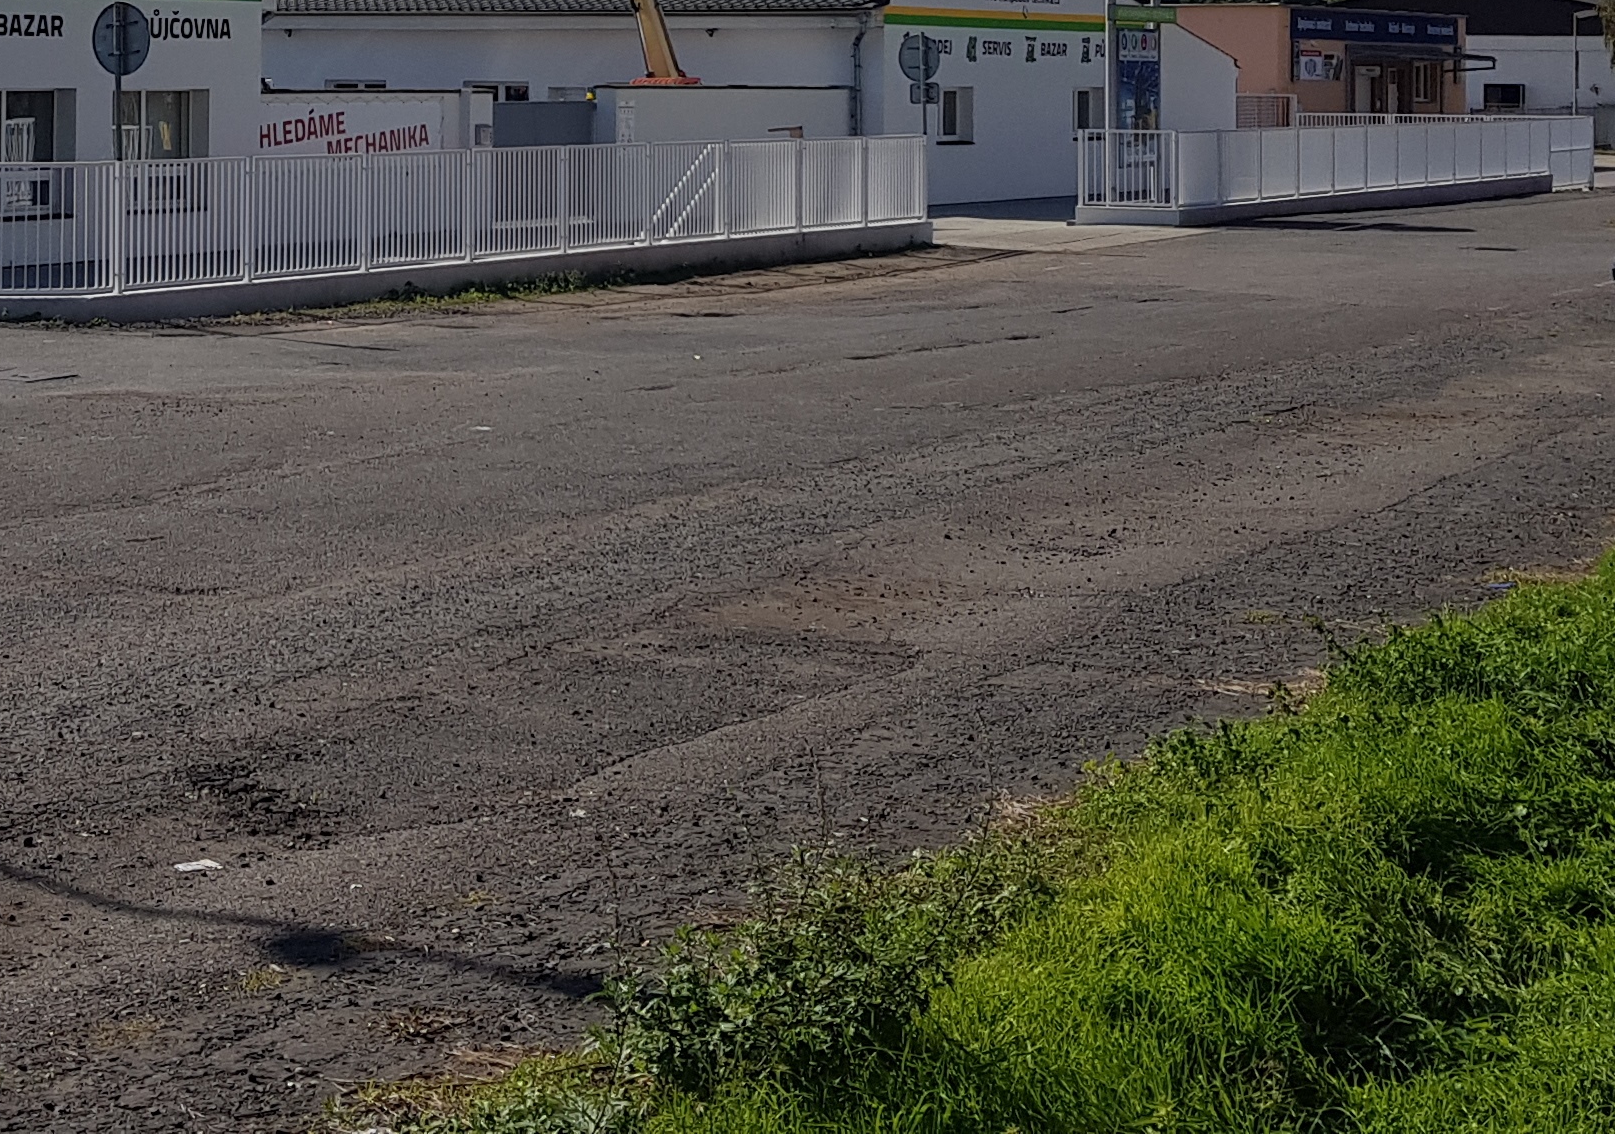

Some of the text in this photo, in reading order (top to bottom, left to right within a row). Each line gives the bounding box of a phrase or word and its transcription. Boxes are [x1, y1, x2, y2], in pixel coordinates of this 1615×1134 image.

[149, 9, 231, 40] ŮJČOVNA
[982, 40, 1012, 56] SERVIS
[1041, 42, 1068, 57] BAZAR
[259, 108, 346, 148] HLEDÁME
[327, 124, 430, 158] MECHANIKA
